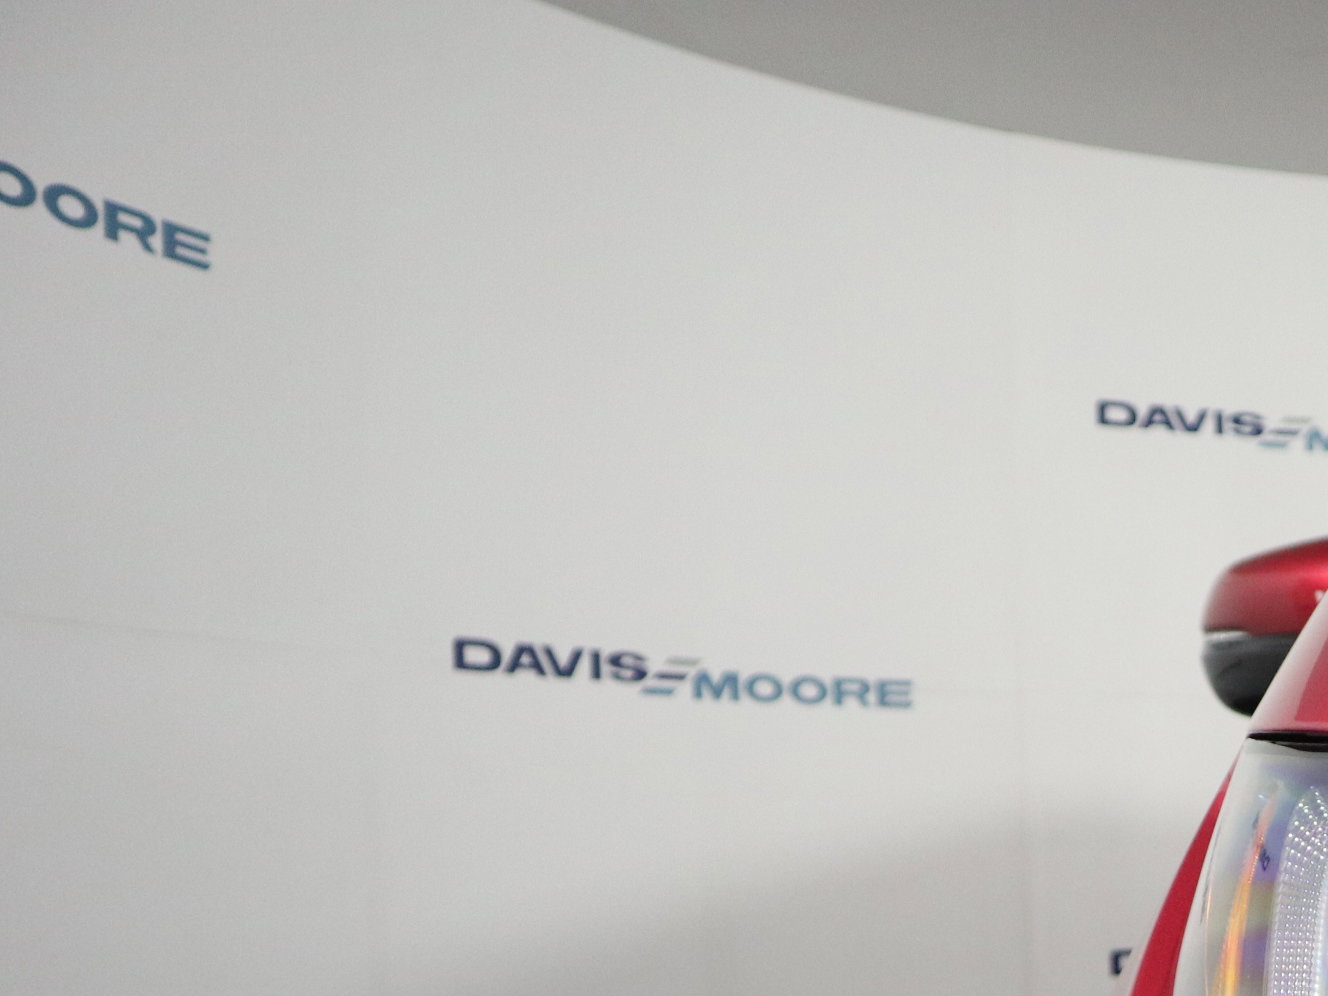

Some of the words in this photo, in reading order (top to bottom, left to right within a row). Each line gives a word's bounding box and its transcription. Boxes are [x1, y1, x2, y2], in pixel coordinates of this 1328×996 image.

[1096, 399, 1265, 437] DAVIS
[453, 636, 649, 683] DAVIS
[692, 668, 914, 710] MOORE
